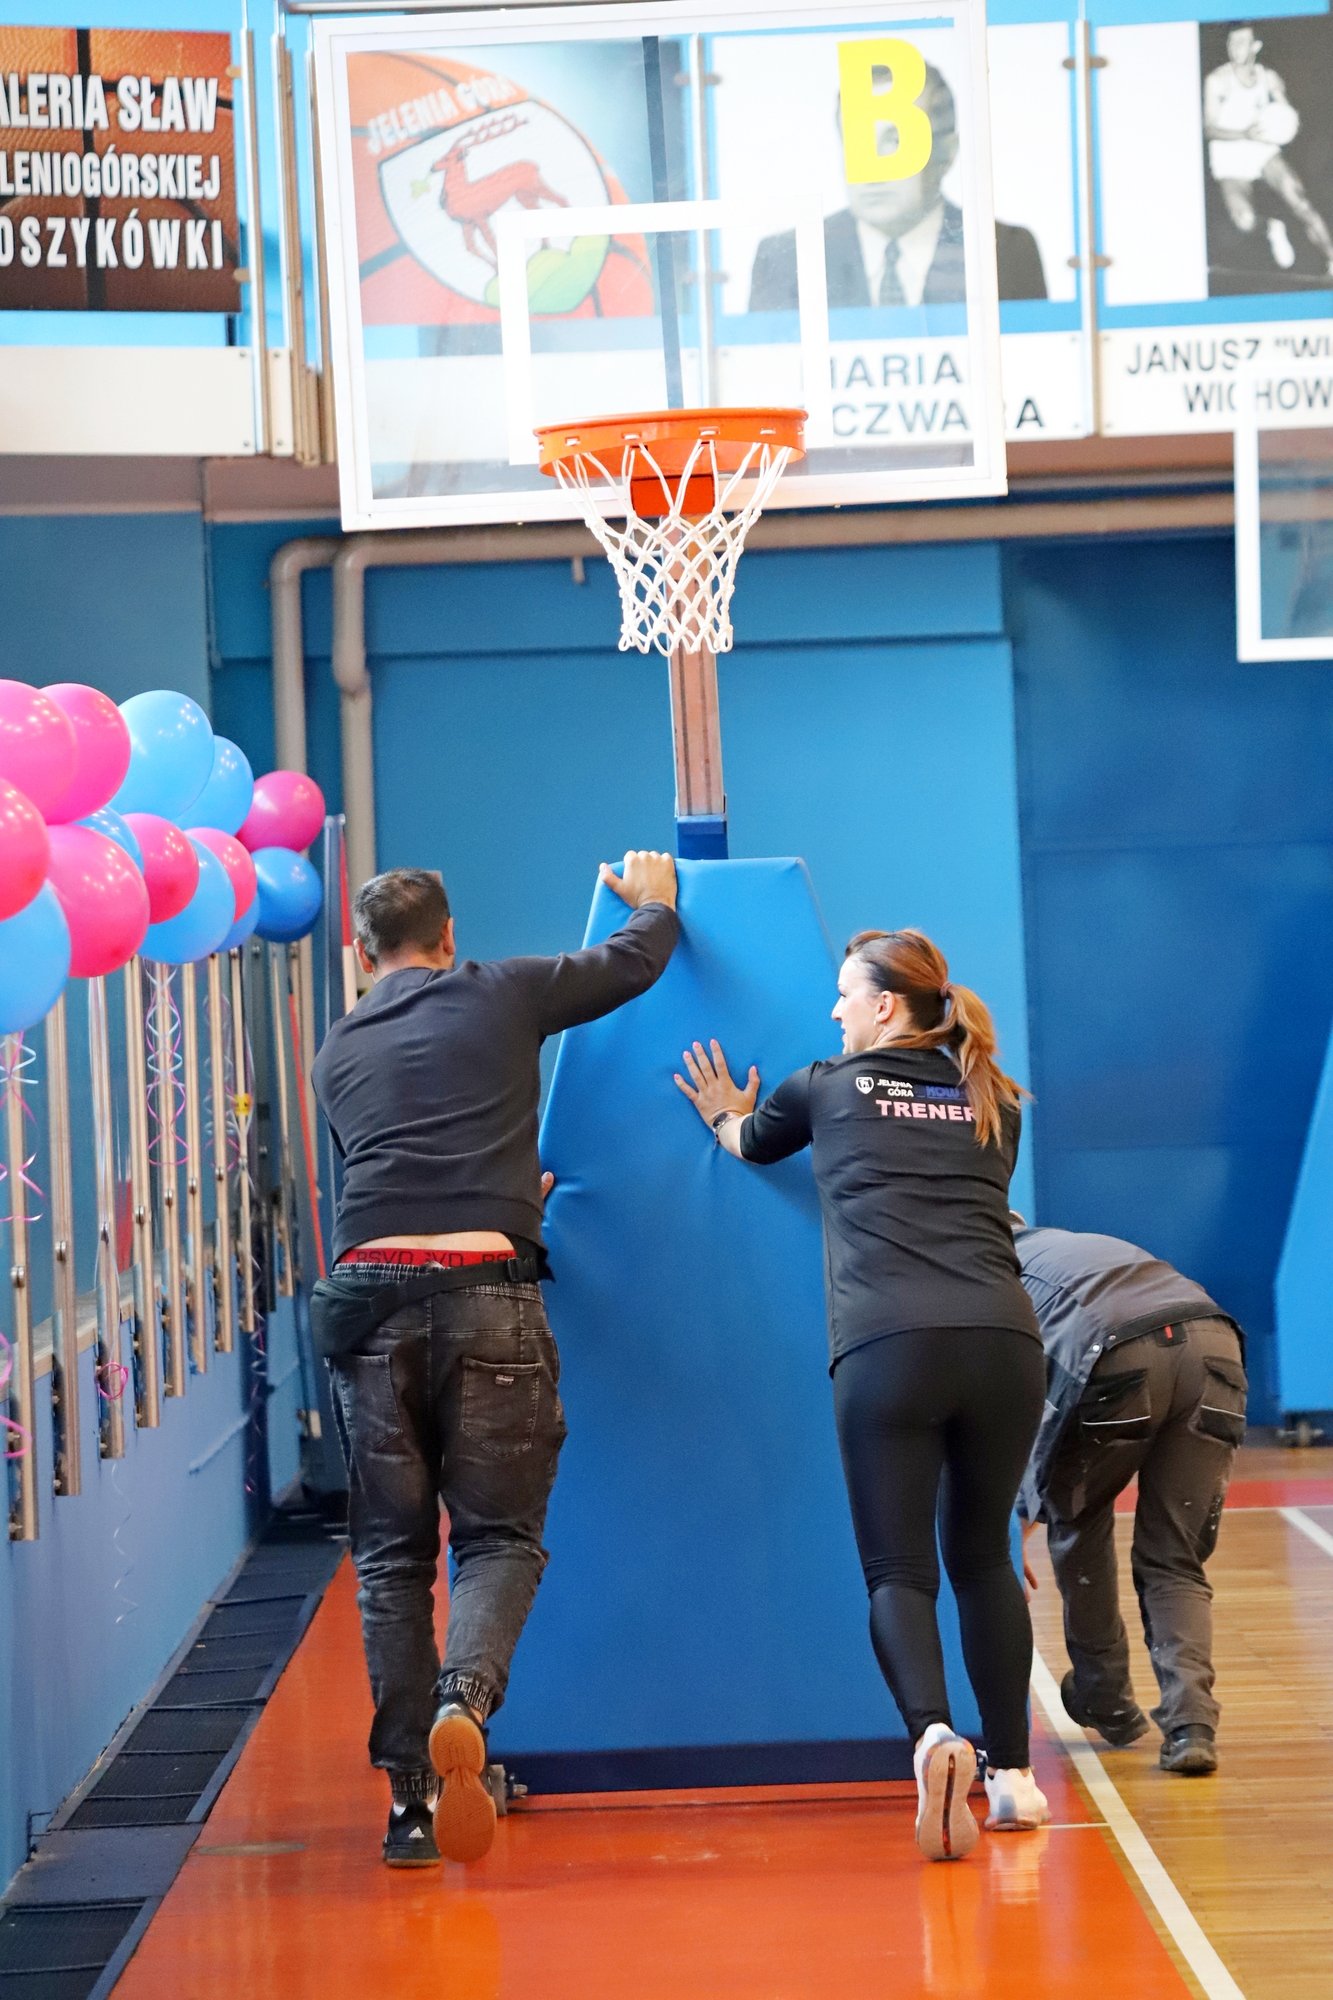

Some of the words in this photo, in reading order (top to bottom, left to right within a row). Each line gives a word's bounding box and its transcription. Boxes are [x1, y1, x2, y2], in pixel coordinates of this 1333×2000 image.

[117, 75, 218, 132] SŁAW
[837, 38, 932, 184] B
[0, 144, 220, 200] LENIOGÓRSKIEJ
[0, 208, 223, 269] OSZYKÓWKI
[829, 351, 963, 390] ARIA
[875, 1099, 976, 1121] TRENER
[887, 1086, 914, 1098] GÓRA
